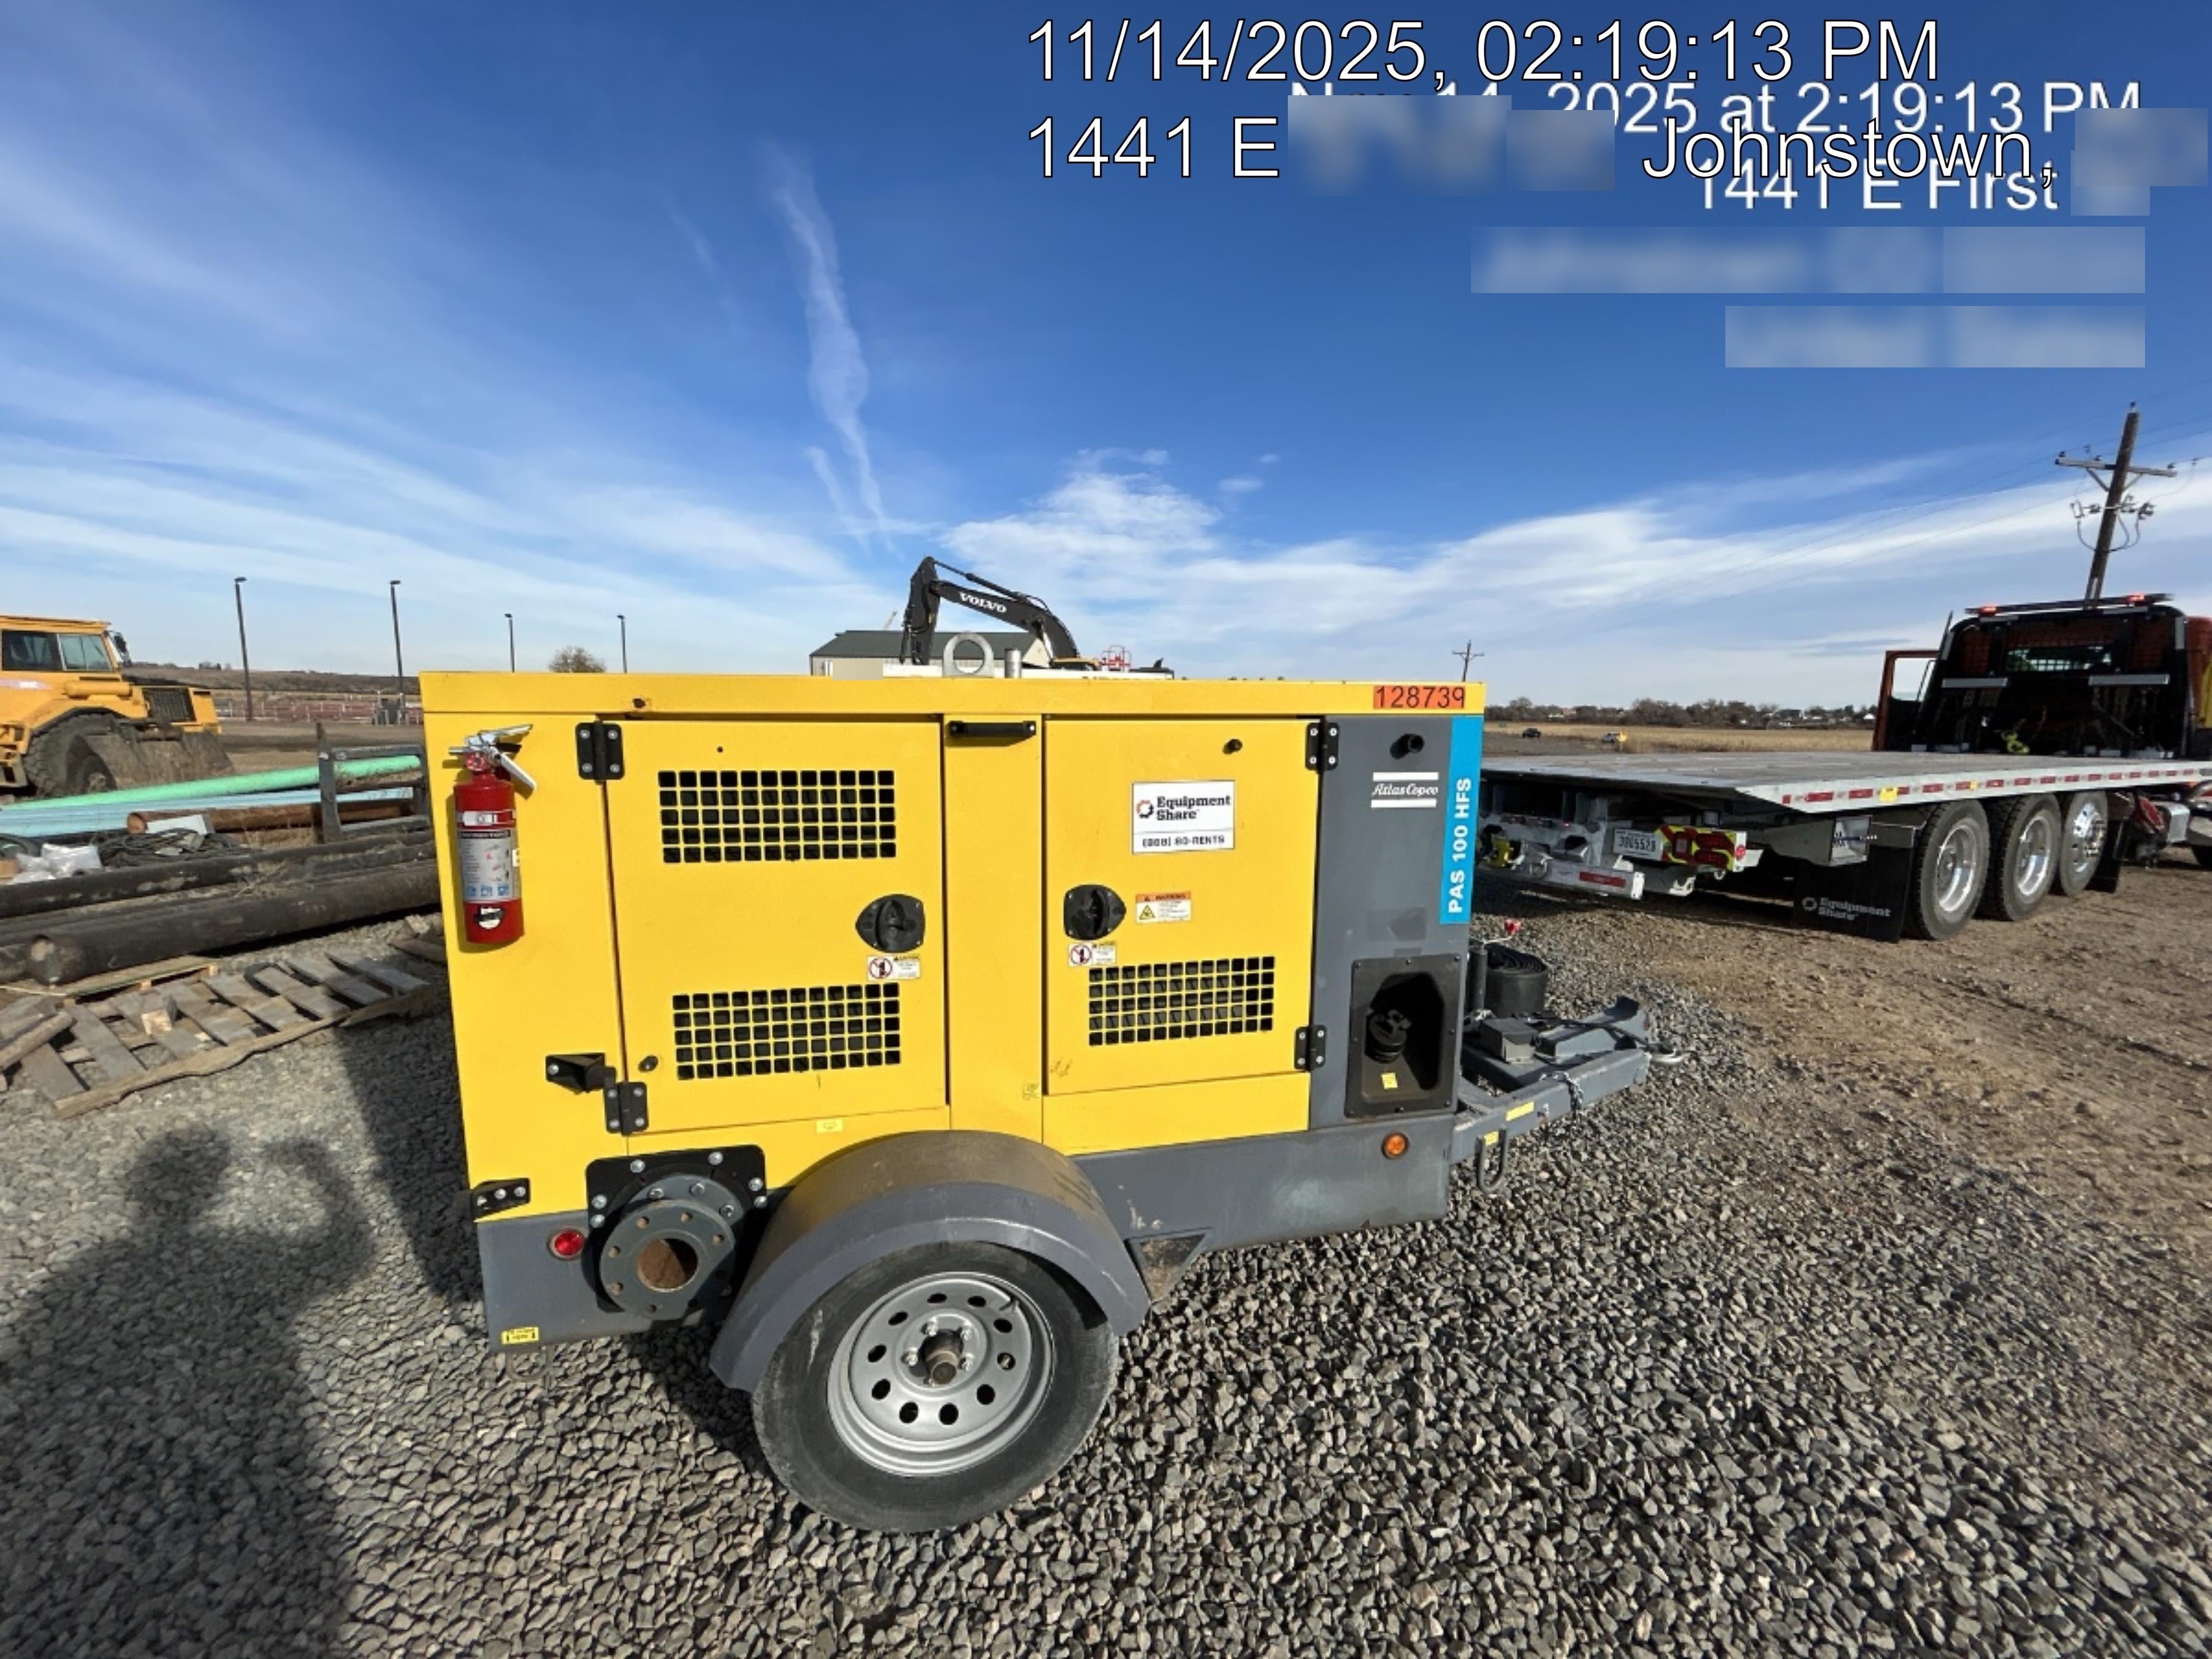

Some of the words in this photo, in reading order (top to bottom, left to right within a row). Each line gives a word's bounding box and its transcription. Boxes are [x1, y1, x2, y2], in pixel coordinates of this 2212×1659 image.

[959, 591, 1007, 613] VOLVO
[1375, 684, 1465, 708] 128739
[1371, 783, 1405, 796] Atlas
[1406, 783, 1438, 797] Copco
[1454, 778, 1472, 818] HFS
[1156, 795, 1231, 810] Equipment
[1156, 809, 1198, 821] Share
[1452, 825, 1468, 861] 100
[1448, 869, 1465, 914] PAS
